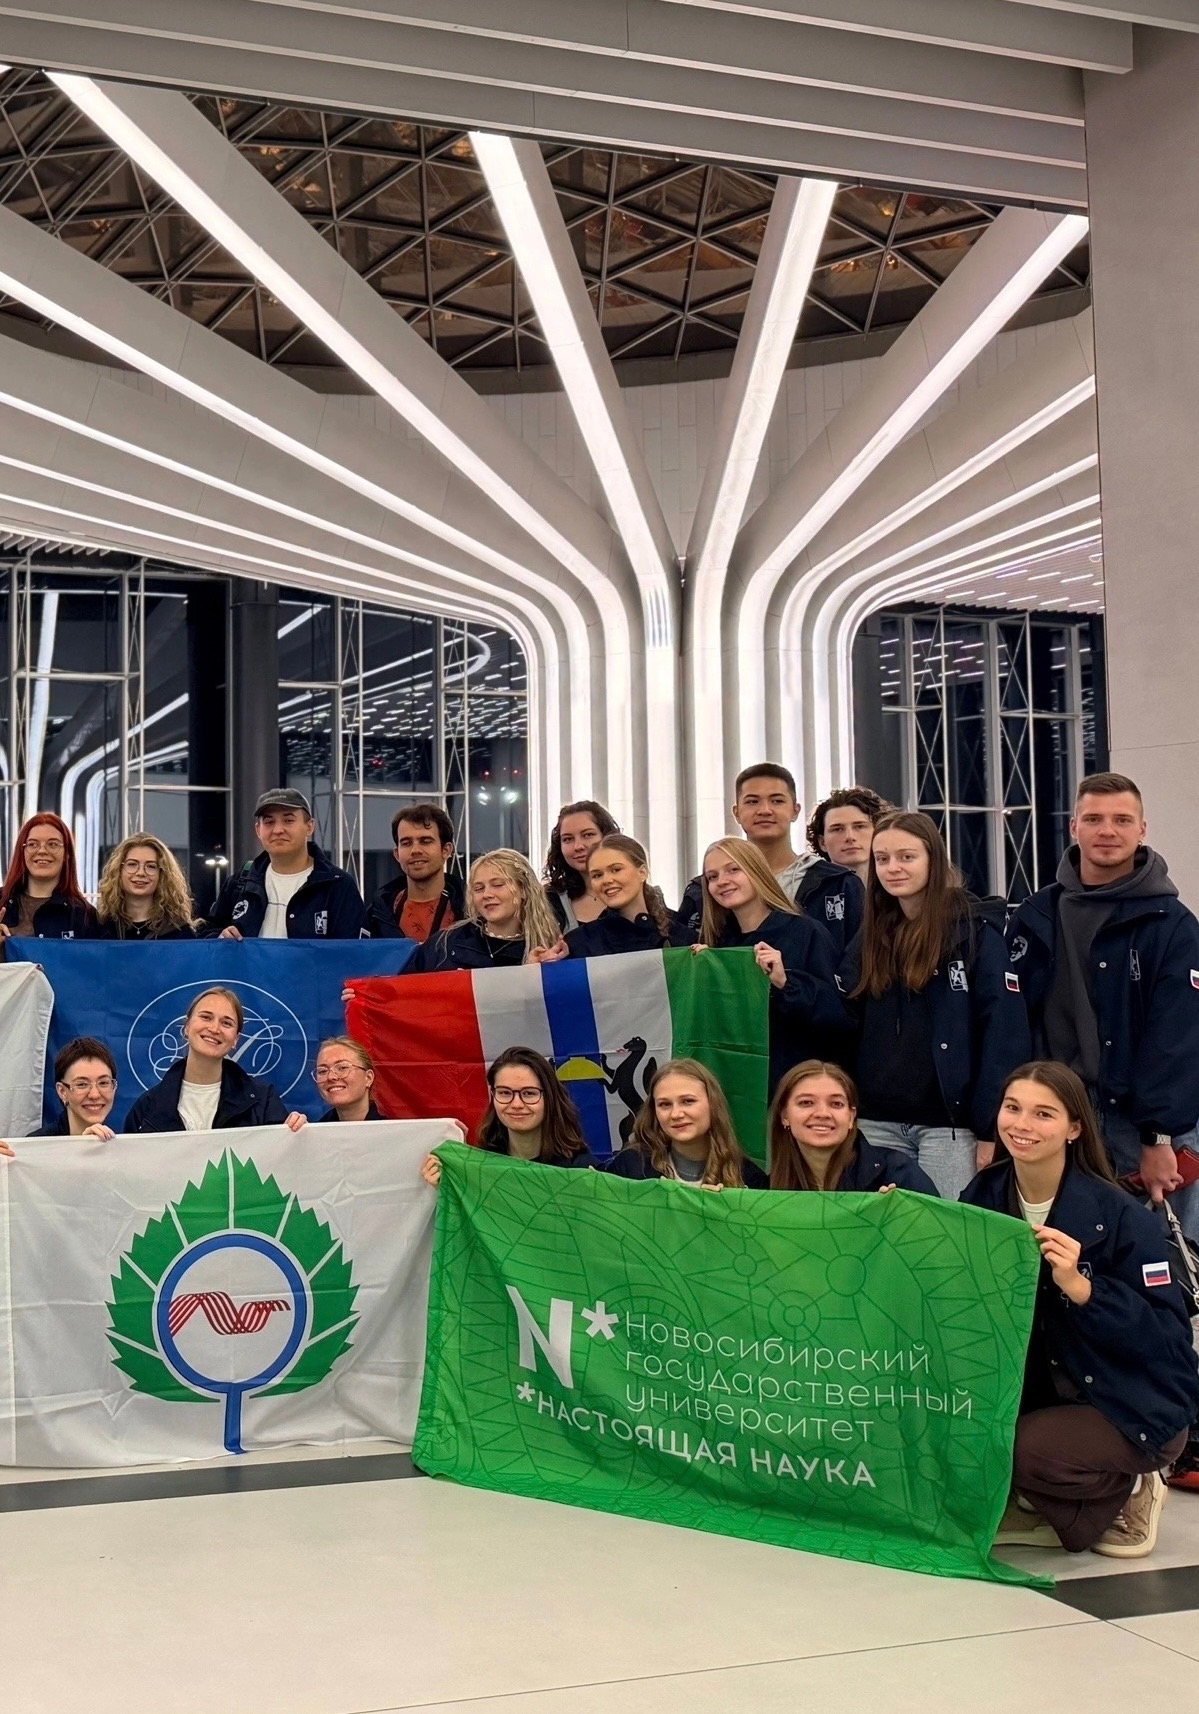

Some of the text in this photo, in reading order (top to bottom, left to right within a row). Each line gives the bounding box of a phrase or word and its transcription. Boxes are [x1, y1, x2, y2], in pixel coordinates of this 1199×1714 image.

[625, 1311, 930, 1375] Новосибирский
[625, 1351, 974, 1420] государственный
[625, 1384, 875, 1443] университет
[750, 1447, 877, 1488] НАУКА
